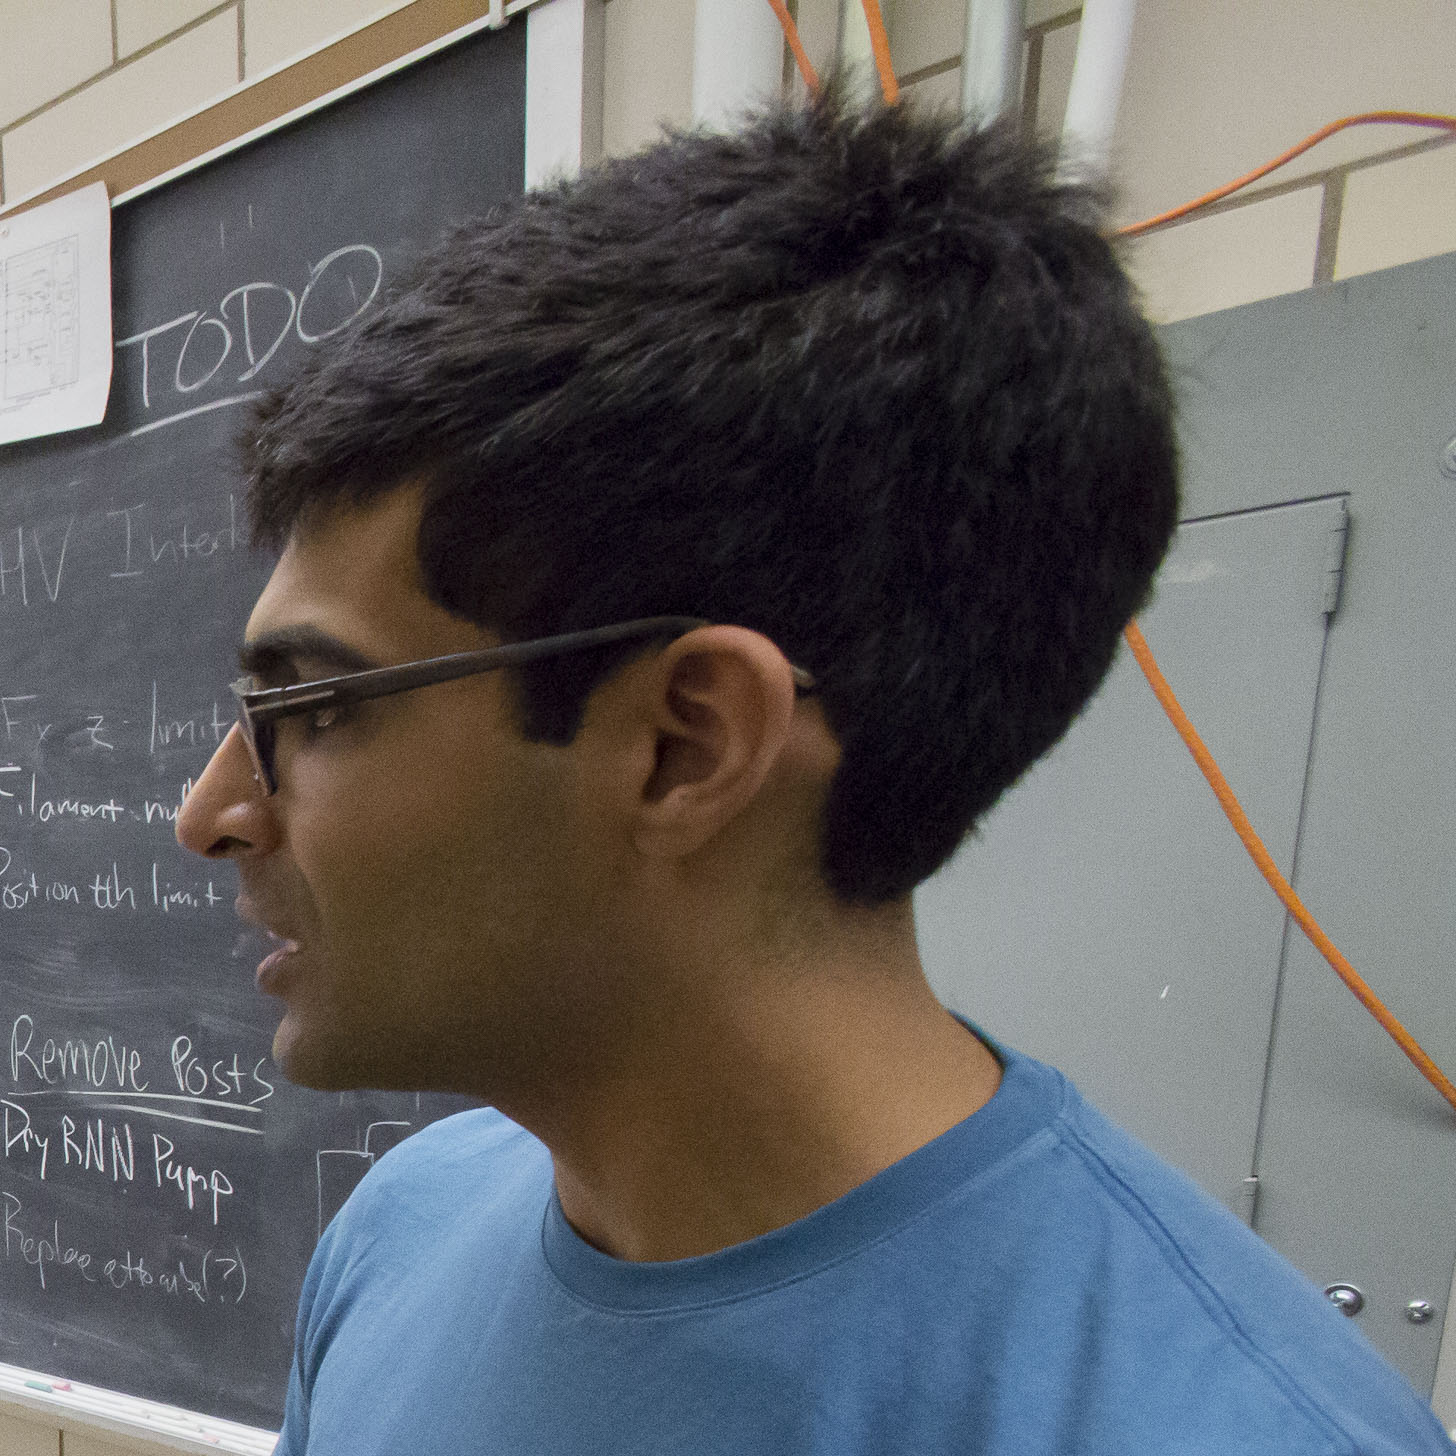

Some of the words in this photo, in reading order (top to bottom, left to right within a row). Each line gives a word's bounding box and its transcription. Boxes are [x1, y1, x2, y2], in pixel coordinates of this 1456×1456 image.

[116, 243, 383, 410] TODO
[171, 1034, 275, 1106] Posts
[152, 1132, 234, 1226] Pump
